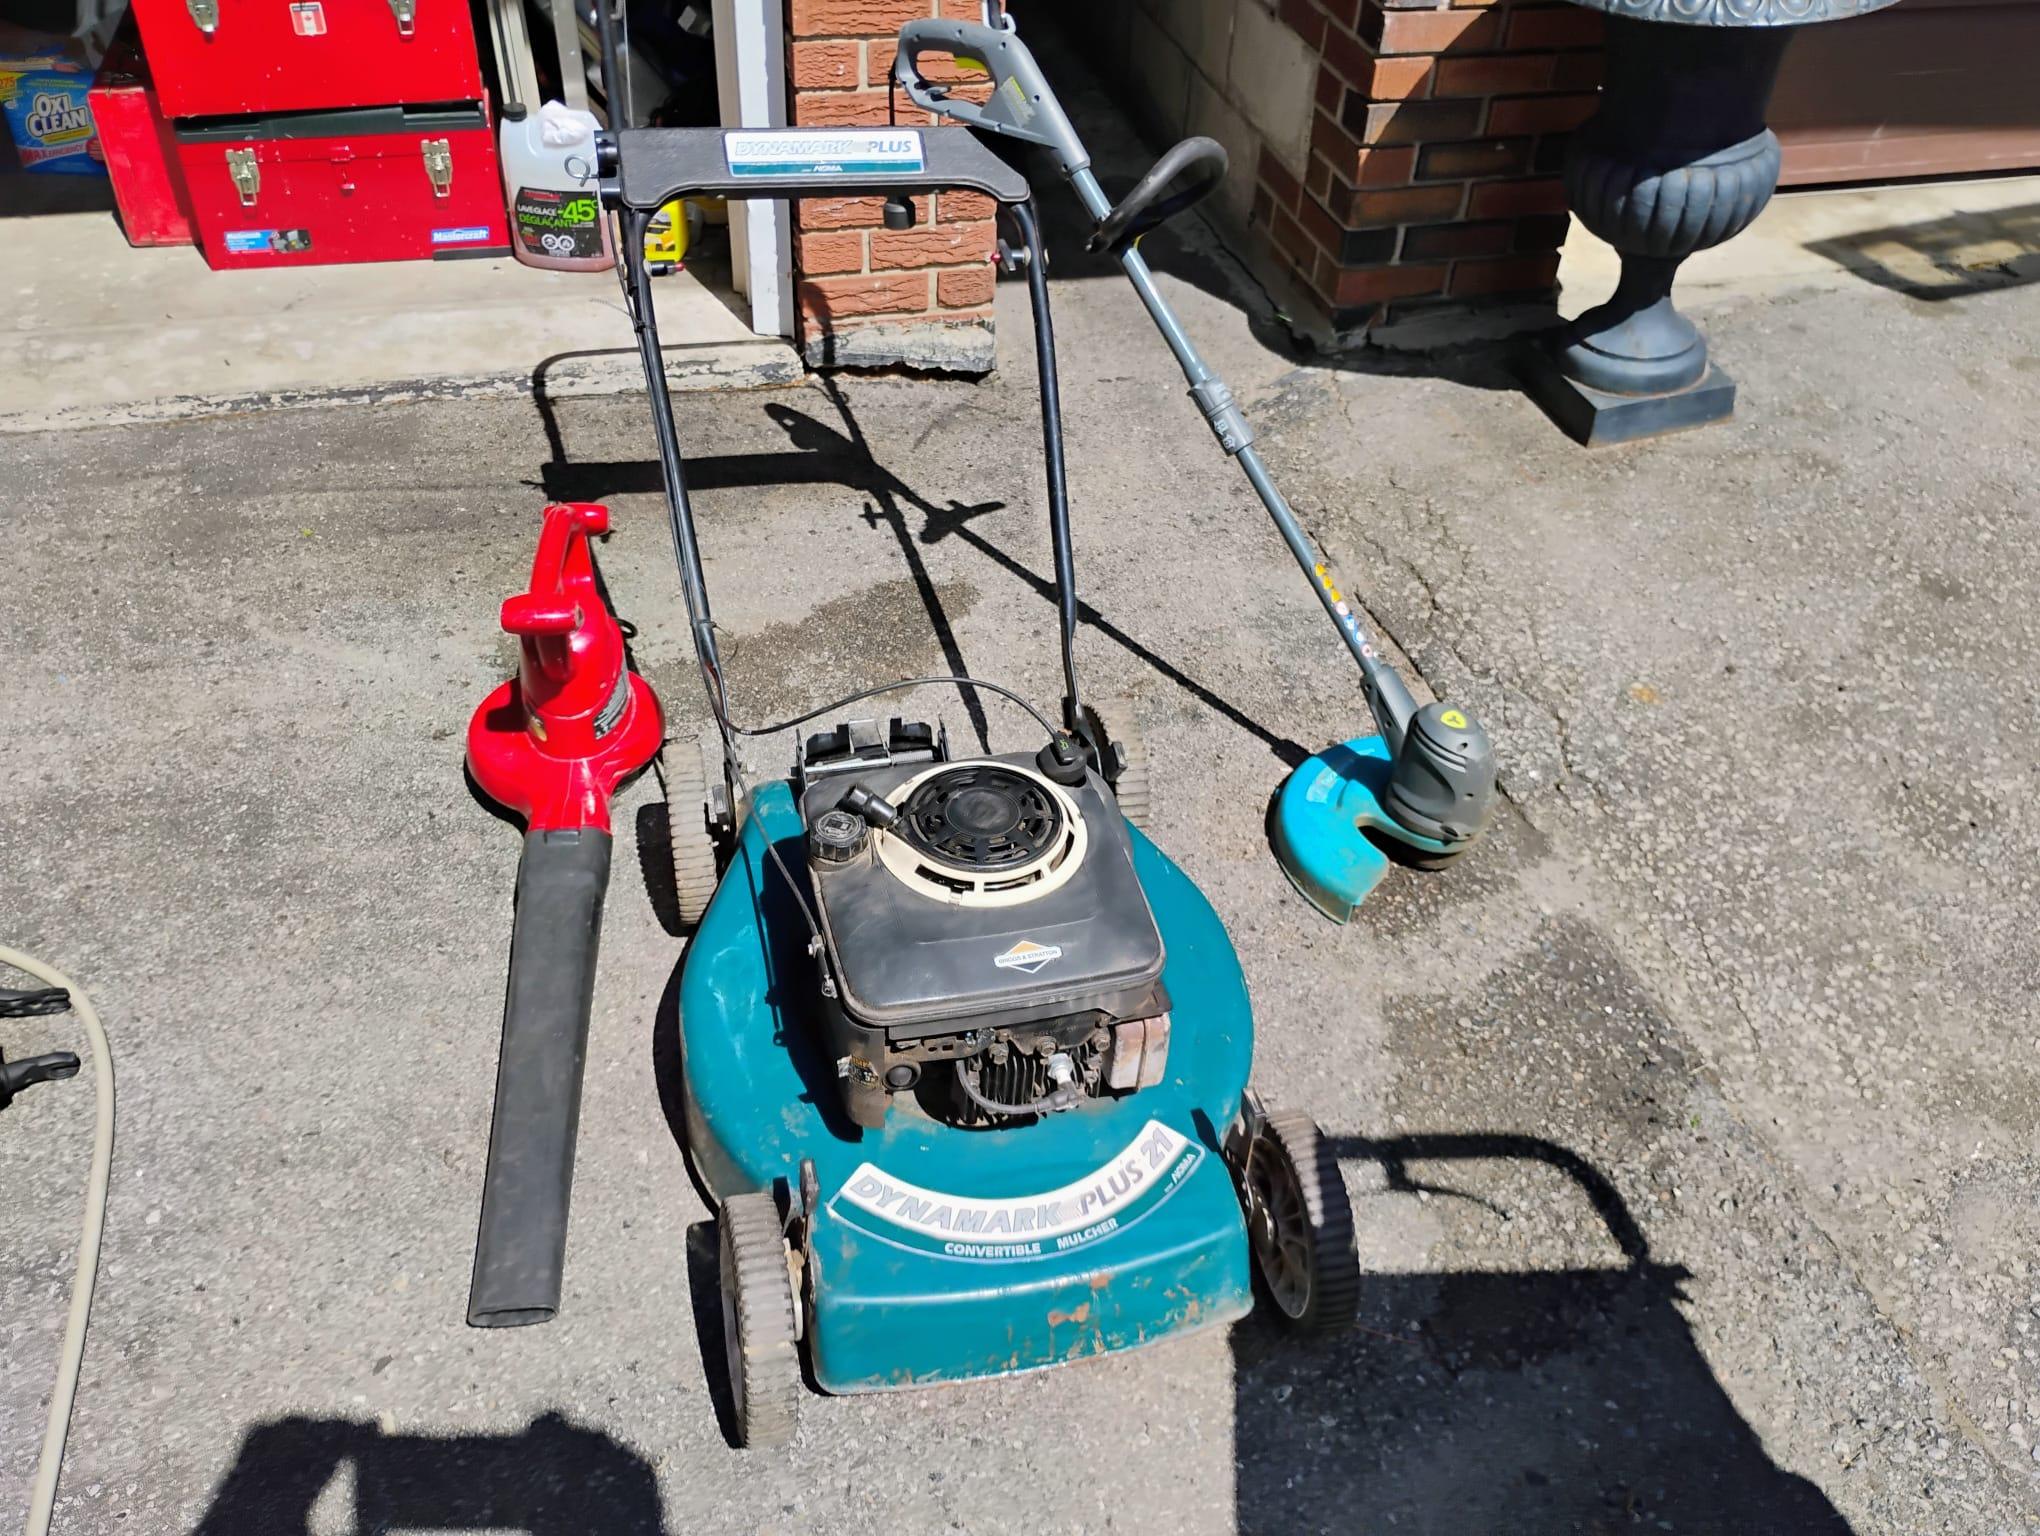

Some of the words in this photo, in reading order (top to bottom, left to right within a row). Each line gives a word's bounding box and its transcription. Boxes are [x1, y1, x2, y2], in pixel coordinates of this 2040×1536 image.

[35, 94, 70, 117] OXI
[28, 108, 87, 137] CLEAN
[735, 140, 852, 156] DYNAMARK
[867, 140, 912, 153] PLUS
[849, 1174, 1064, 1234] DYNAMARK
[1078, 1157, 1144, 1216] PLUS
[1140, 1127, 1174, 1170] 21
[944, 1242, 1042, 1257] CONVERTIBLE
[1057, 1217, 1119, 1251] MULCHER
